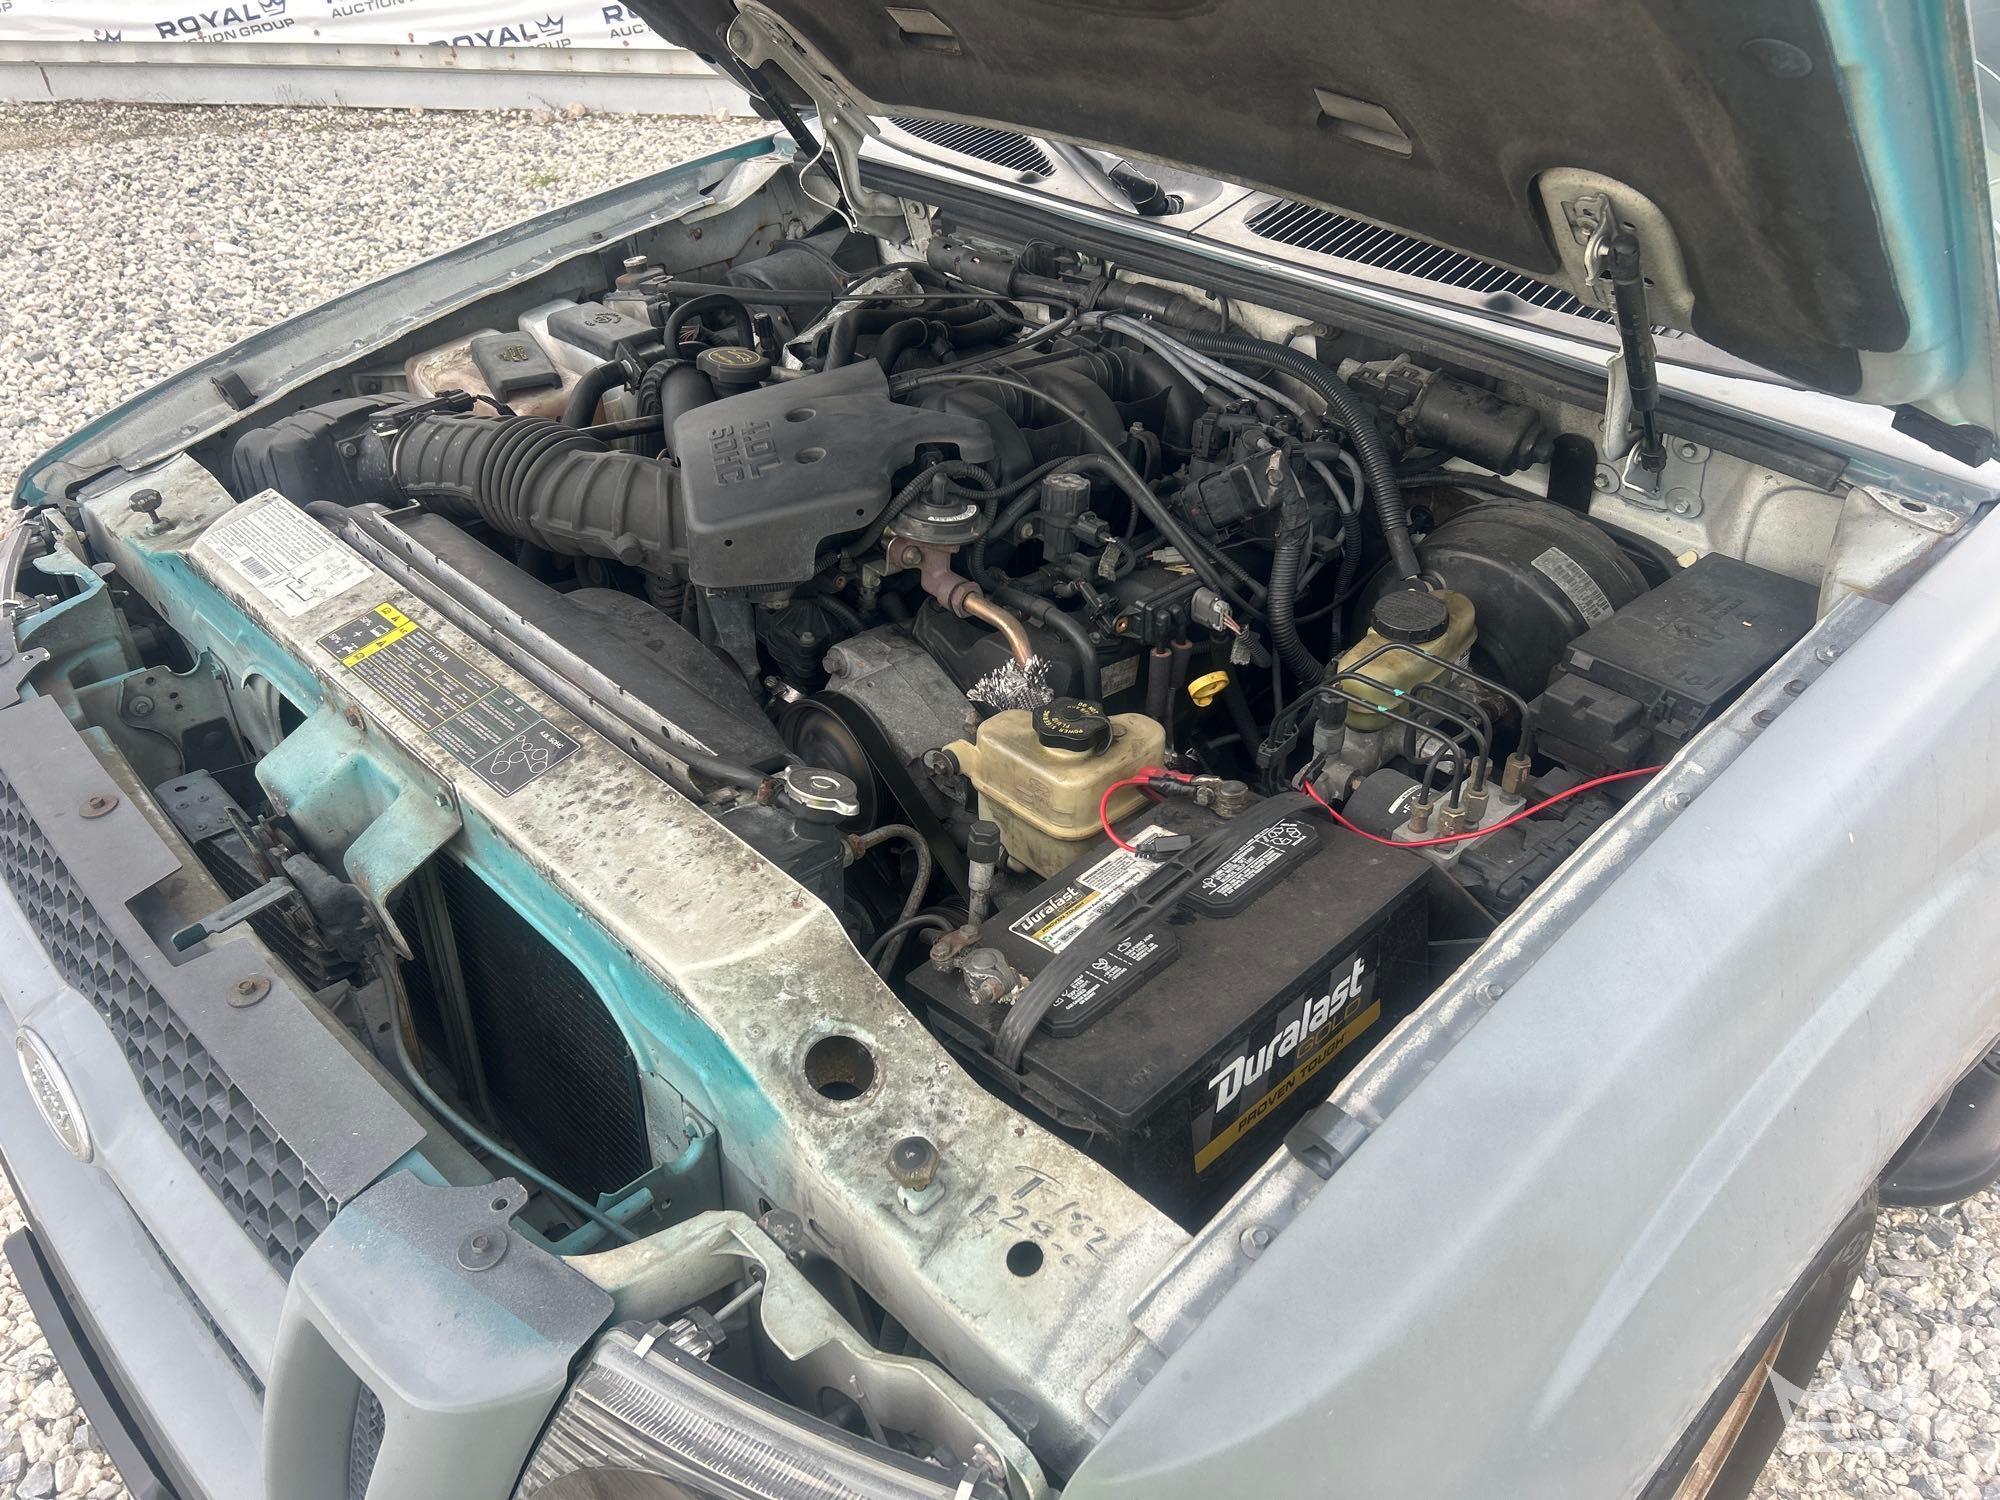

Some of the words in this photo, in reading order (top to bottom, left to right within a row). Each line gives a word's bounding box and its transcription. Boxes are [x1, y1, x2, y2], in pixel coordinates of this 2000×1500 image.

[155, 4, 261, 39] ROYAL
[240, 18, 295, 37] GROUP
[709, 424, 745, 485] SOHC
[427, 645, 449, 663] R-134A
[1208, 957, 1365, 1114] Duralast
[1297, 996, 1361, 1060] GOLD
[1237, 1076, 1296, 1133] PROVEN
[1300, 1034, 1345, 1078] TOUGH
